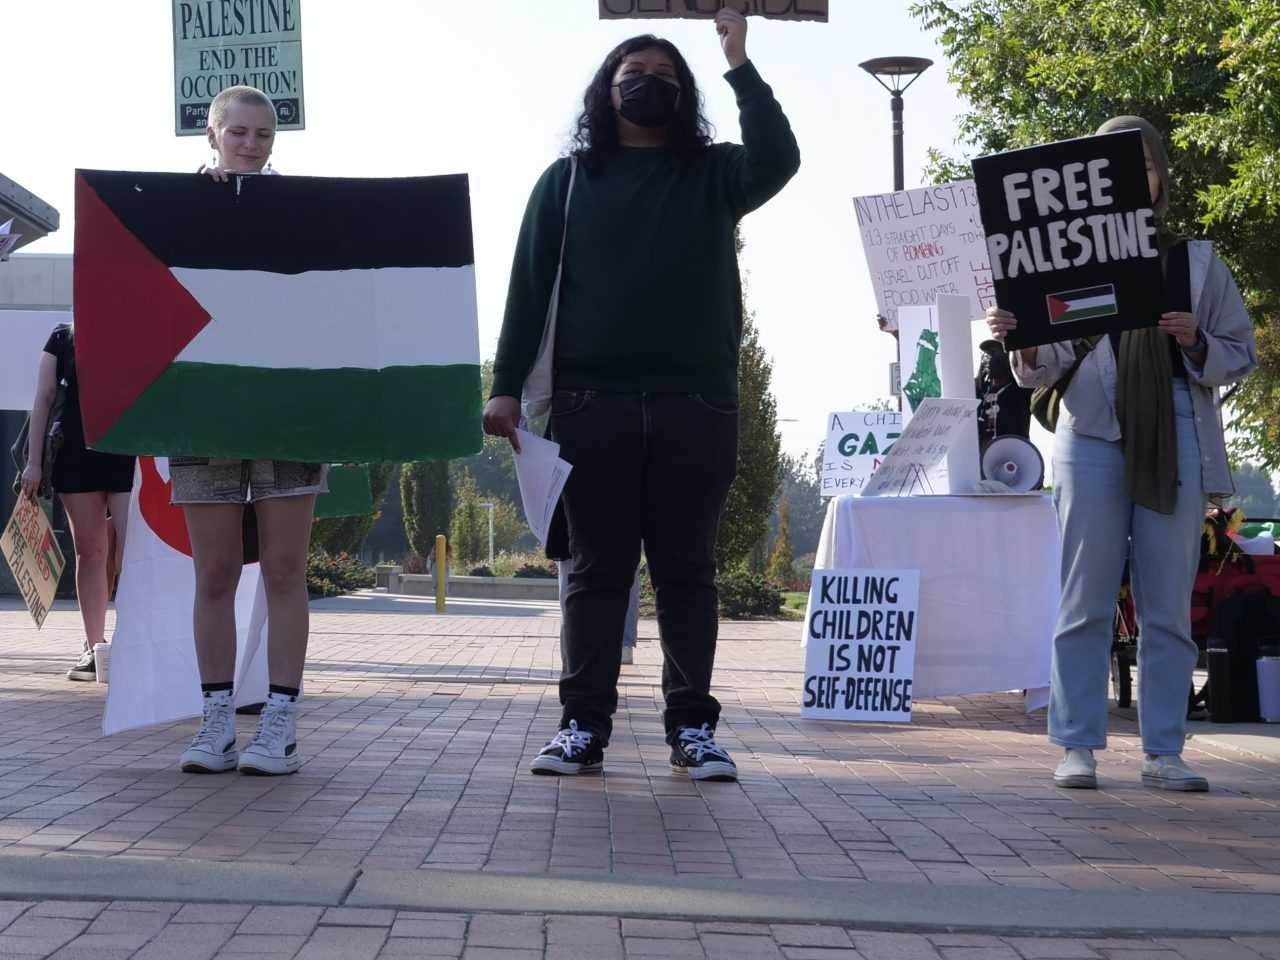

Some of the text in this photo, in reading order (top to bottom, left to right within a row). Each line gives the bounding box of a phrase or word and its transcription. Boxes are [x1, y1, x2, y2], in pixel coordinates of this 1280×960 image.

[199, 45, 278, 71] END THE
[185, 105, 208, 117] Party
[196, 118, 207, 127] an
[867, 190, 908, 221] THE
[906, 185, 957, 216] LAST
[1002, 158, 1113, 222] FREE
[986, 208, 1159, 281] PALESTINE
[916, 261, 939, 281] CUT
[939, 255, 960, 276] OFF
[883, 288, 920, 306] FOOD
[863, 413, 901, 426] CHI
[838, 431, 900, 457] GAZ
[825, 459, 853, 471] IS
[823, 477, 865, 489] EVERY
[9, 545, 47, 624] PALESTINE
[820, 575, 900, 605] KILLING
[809, 610, 914, 641] CHILDREN
[828, 644, 901, 673] IS NOT
[803, 675, 912, 713] SELF-DEFENSE
